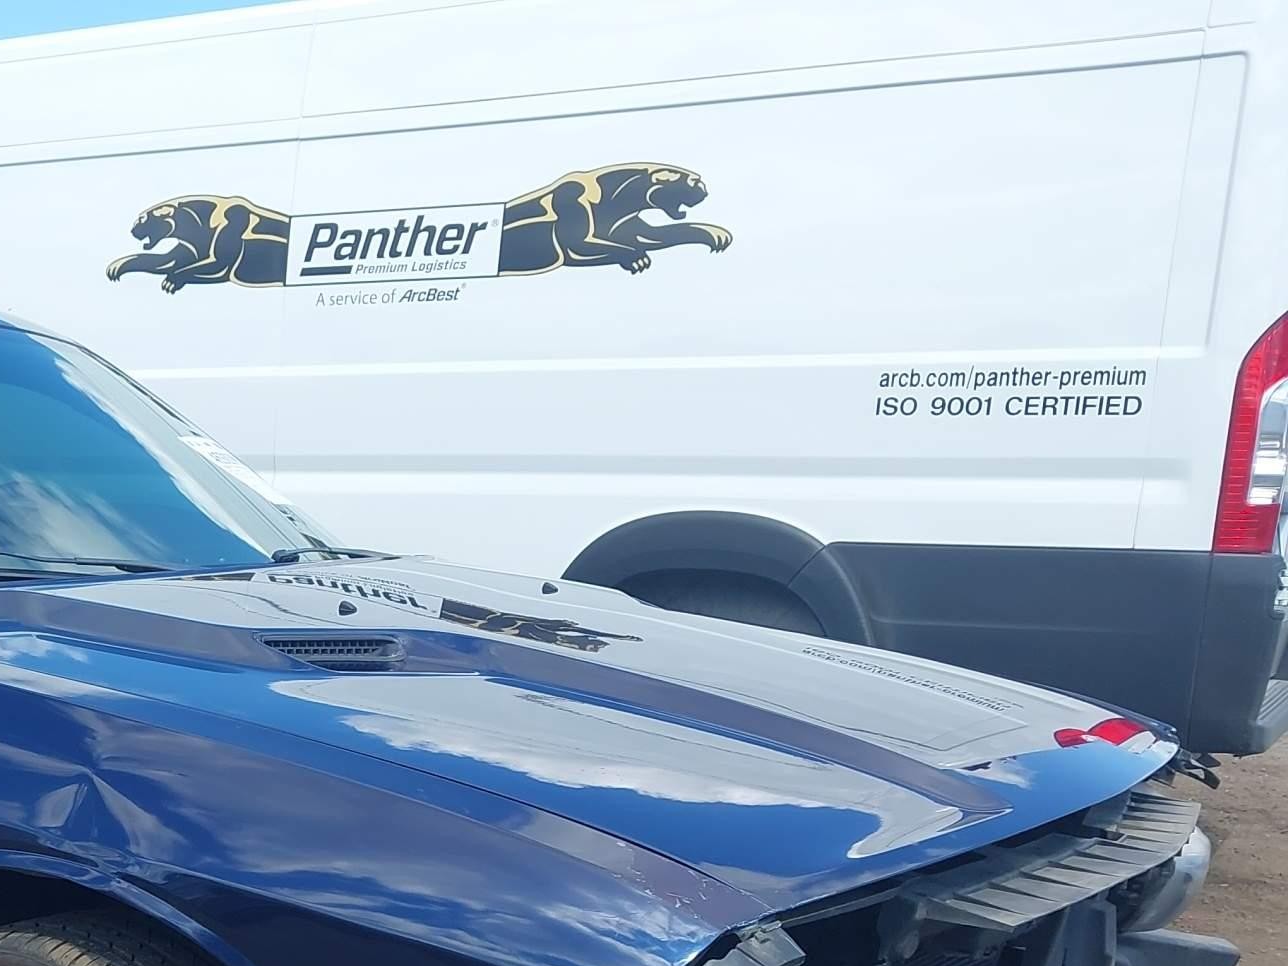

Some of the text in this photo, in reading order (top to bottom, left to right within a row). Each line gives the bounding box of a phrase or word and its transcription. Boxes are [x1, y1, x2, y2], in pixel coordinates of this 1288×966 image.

[304, 215, 489, 262] Panther
[355, 259, 467, 274] Premium Logistics
[315, 287, 461, 306] A service of ArcBest
[879, 365, 1147, 390] arcb.com/panther-premium
[875, 395, 1143, 416] ISO 9001 CERTIFIED
